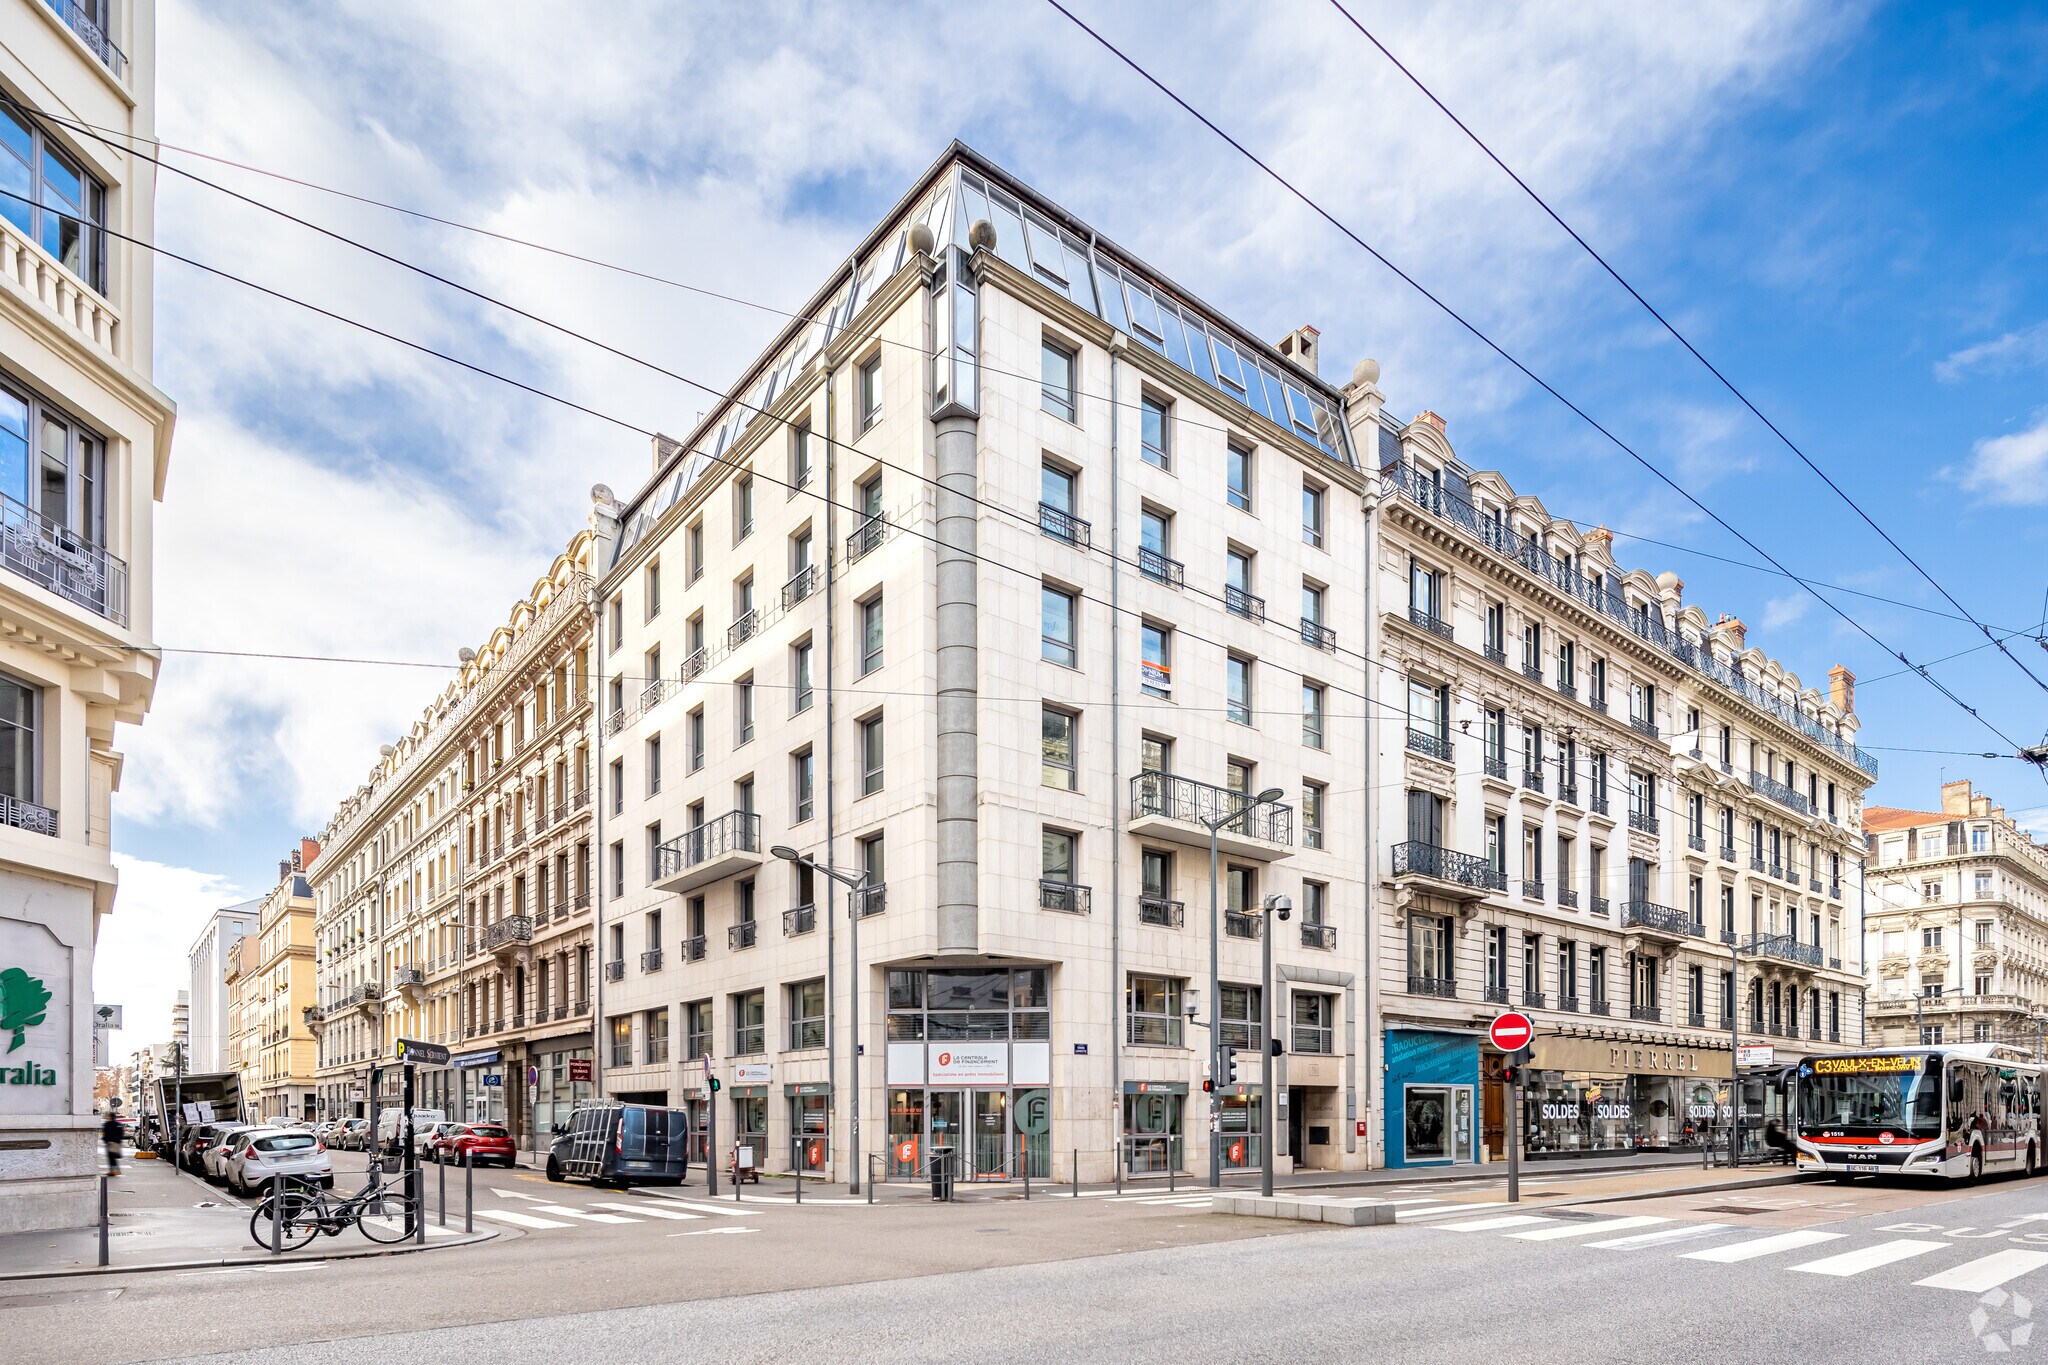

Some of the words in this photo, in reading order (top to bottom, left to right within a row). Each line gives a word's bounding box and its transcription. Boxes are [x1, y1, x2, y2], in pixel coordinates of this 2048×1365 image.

[398, 1042, 405, 1057] P
[407, 1046, 425, 1057] BNNEL
[1610, 1048, 1698, 1071] PIERREL
[1815, 1060, 1832, 1073] C3
[1542, 1104, 1580, 1119] SOLDES
[1597, 1104, 1630, 1119] SOLDES
[1689, 1105, 1716, 1118] SOLDES
